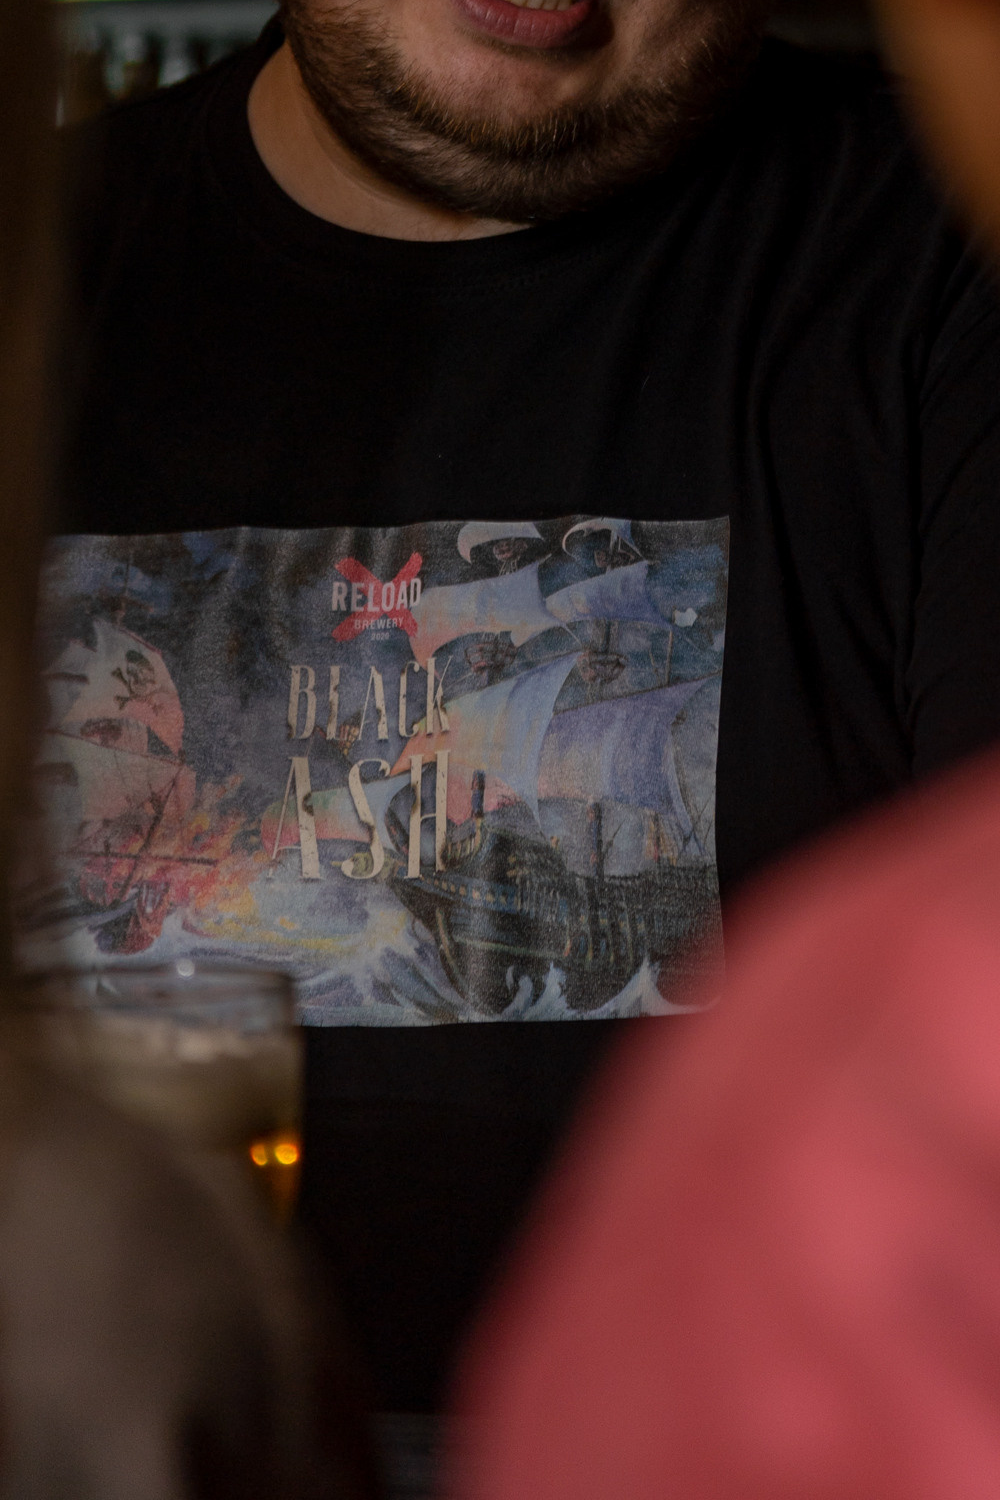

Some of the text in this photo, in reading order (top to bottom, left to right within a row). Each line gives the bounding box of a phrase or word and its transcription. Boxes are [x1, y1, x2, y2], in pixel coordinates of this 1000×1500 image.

[331, 577, 422, 612] RELOAD
[354, 617, 405, 630] BREWERY
[286, 654, 454, 741] BLACK
[264, 749, 451, 881] ASH
